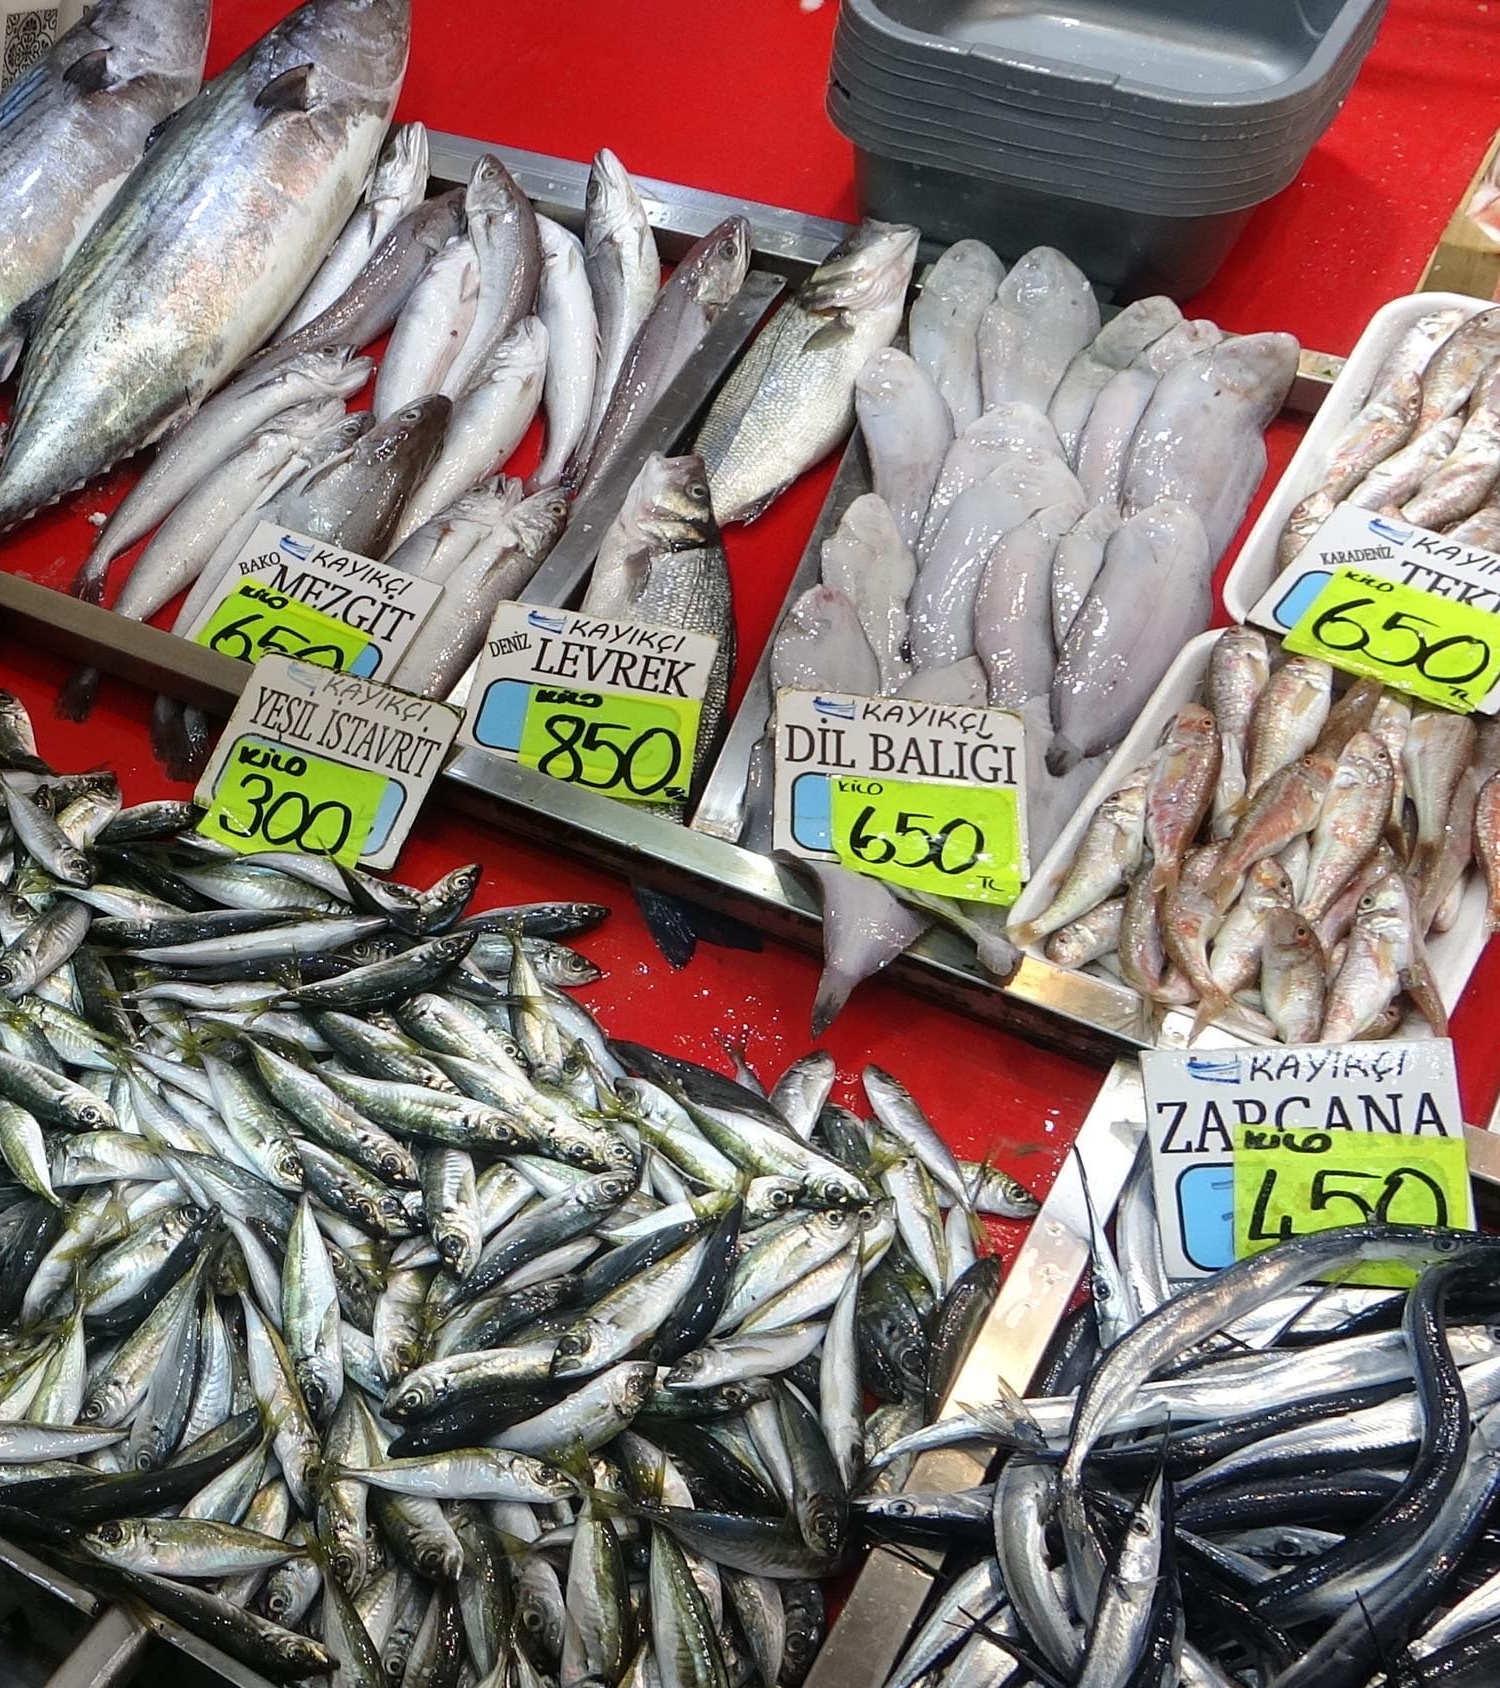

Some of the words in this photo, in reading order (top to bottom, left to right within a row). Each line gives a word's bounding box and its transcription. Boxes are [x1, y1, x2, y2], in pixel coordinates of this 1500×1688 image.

[238, 551, 282, 577] BAKO
[311, 549, 414, 597] KAYIKÇI
[1319, 544, 1396, 566] KARADENİZ
[487, 631, 532, 658] DENİZ
[569, 619, 687, 654] KAYIKÇI
[1311, 597, 1491, 685] 650
[531, 637, 696, 698] LEVREK
[321, 675, 433, 722] KAYIKÇI
[861, 702, 988, 735] KAYIKÇI
[249, 686, 319, 742] YEŞİL
[316, 700, 443, 778] İSTAVRİT
[537, 714, 682, 796] 850
[784, 717, 856, 769] DİL
[868, 730, 1018, 785] BALIĞI
[218, 773, 353, 856] 300
[849, 805, 985, 875] 650
[1248, 1166, 1449, 1241] 450
